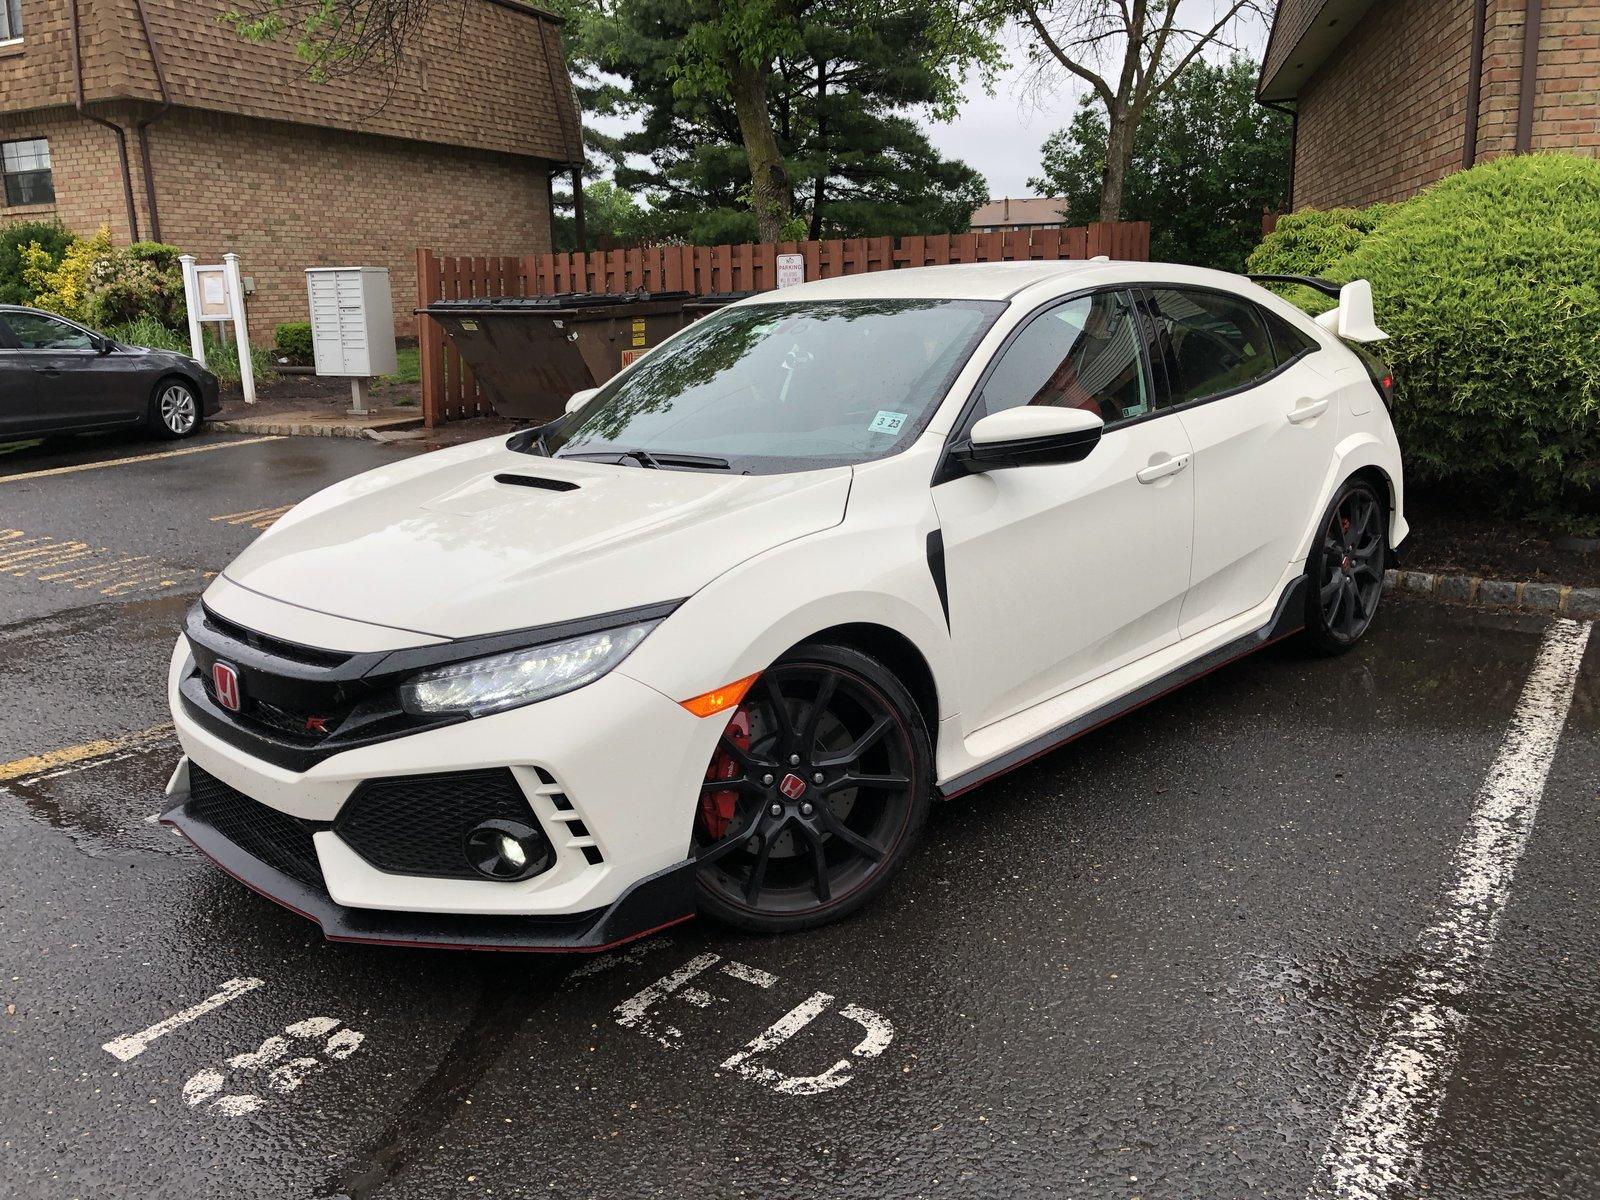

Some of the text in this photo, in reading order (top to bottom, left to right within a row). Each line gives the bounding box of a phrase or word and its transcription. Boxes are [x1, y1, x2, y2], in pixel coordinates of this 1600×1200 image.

[877, 417, 901, 429] 3 23
[101, 976, 365, 1118] 18
